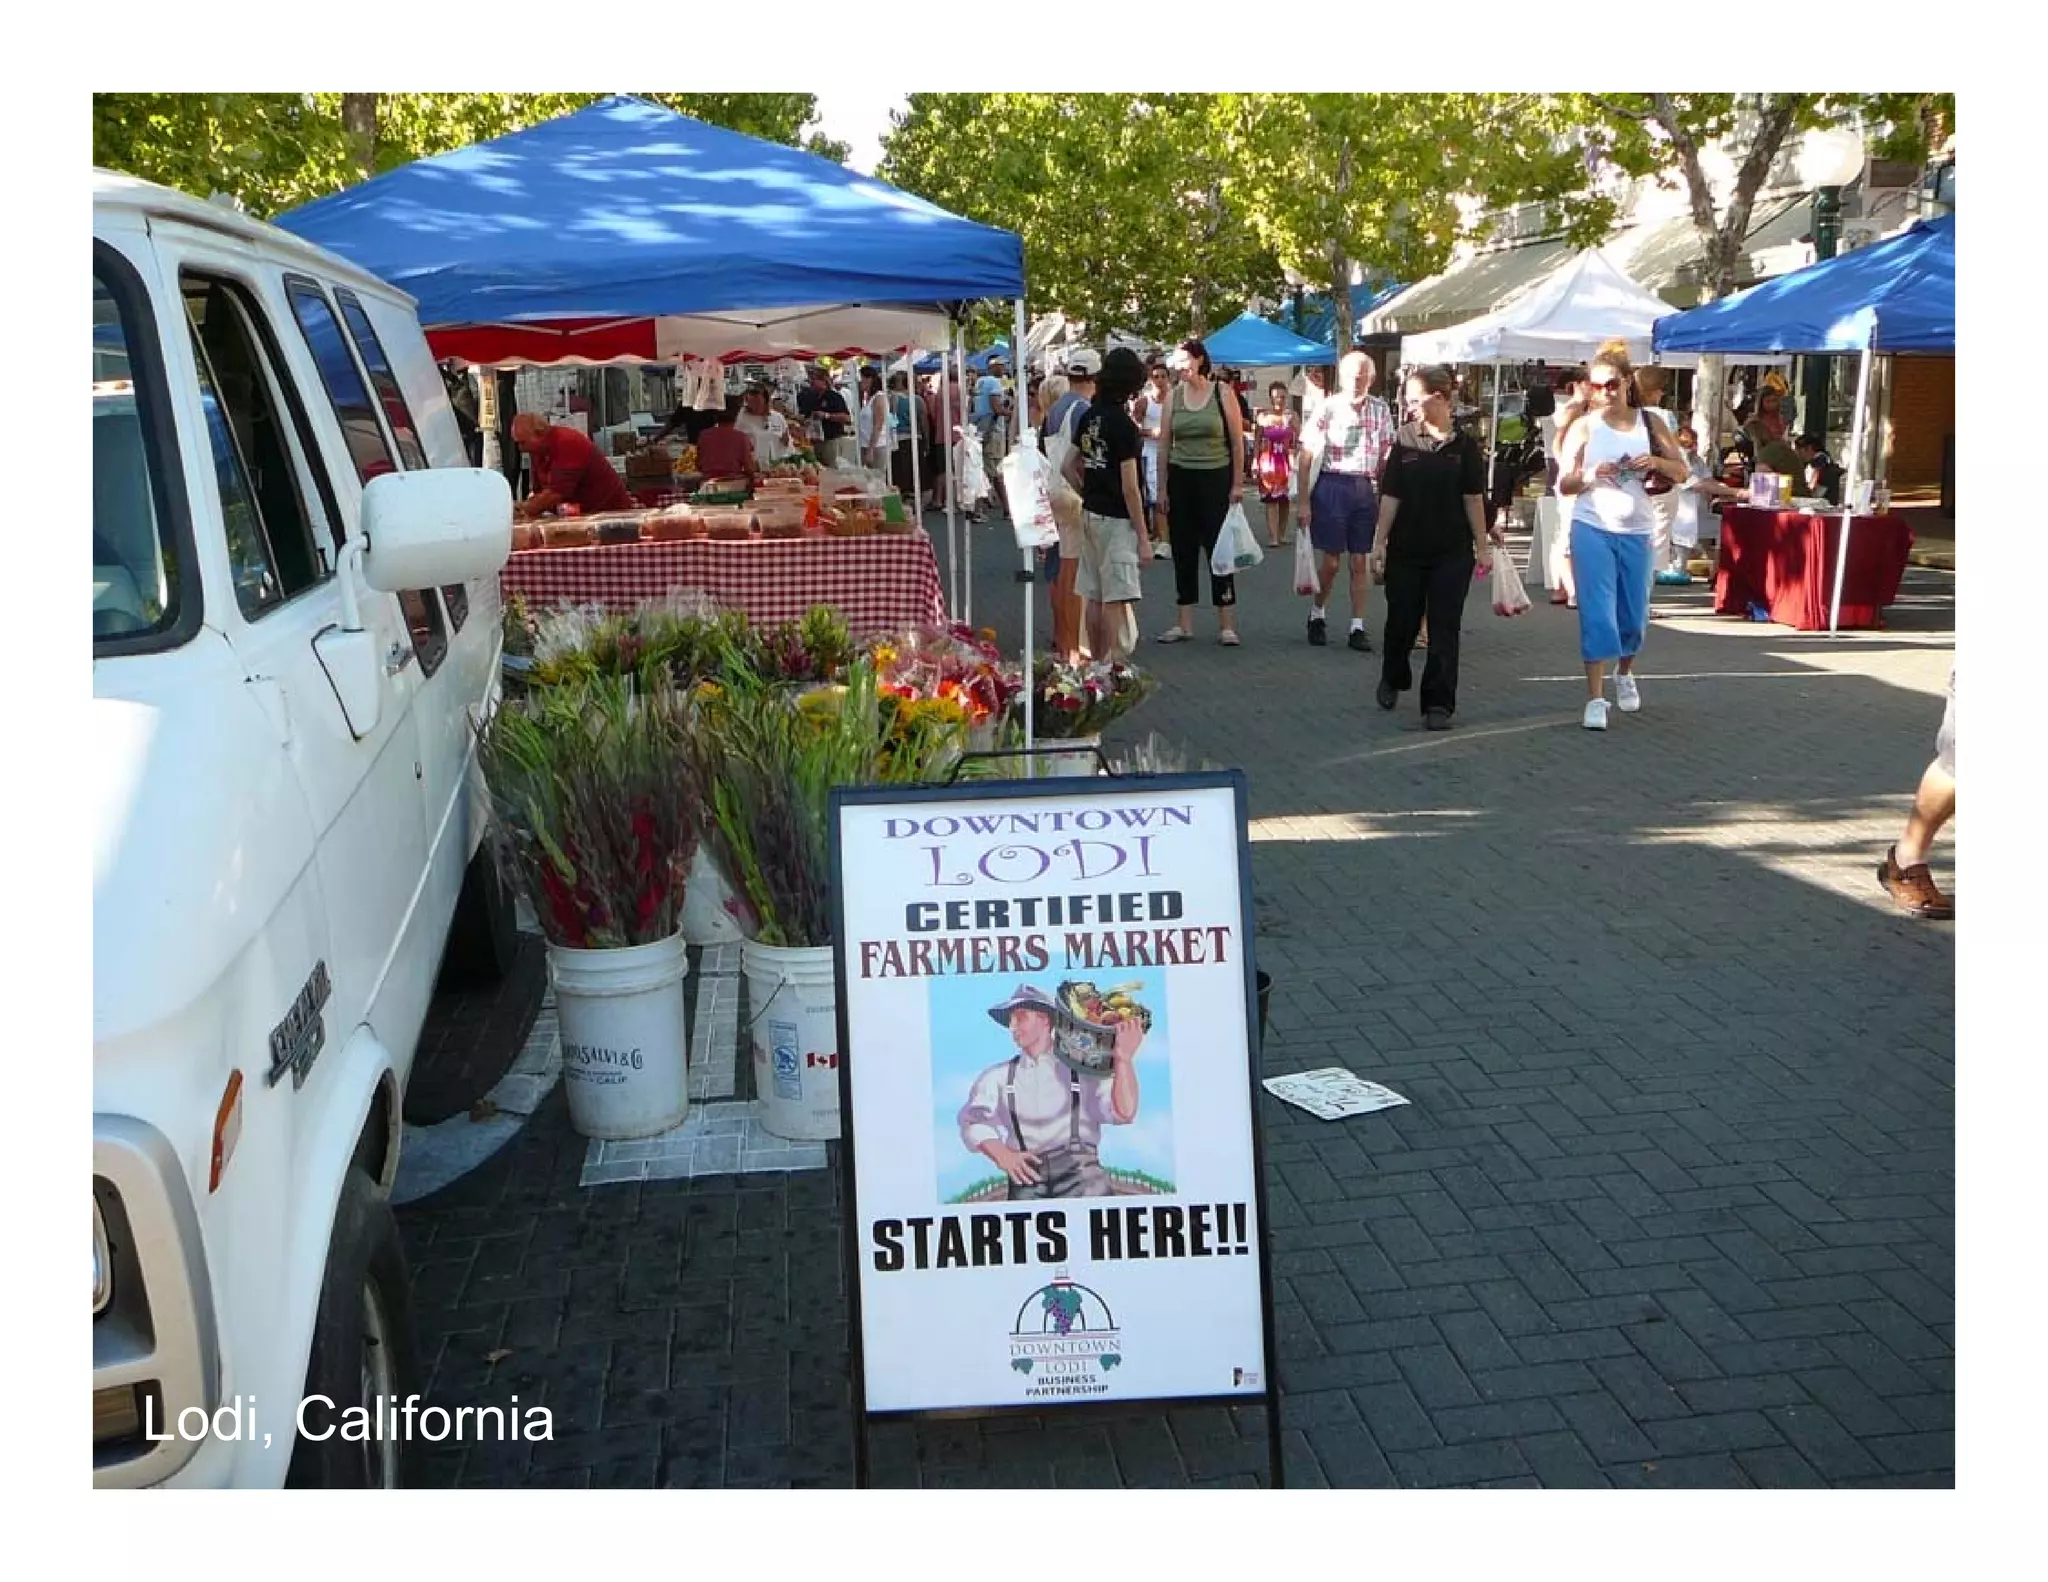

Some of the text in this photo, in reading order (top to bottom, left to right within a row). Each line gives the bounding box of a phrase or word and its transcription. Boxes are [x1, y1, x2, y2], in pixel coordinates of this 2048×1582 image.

[884, 806, 1194, 838] DOWNTOWN
[921, 835, 1161, 886] LODI
[905, 890, 1183, 932] CERTIFIED
[859, 926, 1231, 978] FARMERS MARKET
[872, 1203, 1249, 1271] STARTS HERE!!
[1010, 1340, 1120, 1356] DOWNTOWN
[1038, 1375, 1096, 1385] BUSINESS
[1045, 1361, 1087, 1374] LODI
[1025, 1385, 1108, 1396] PARTNERSHIP
